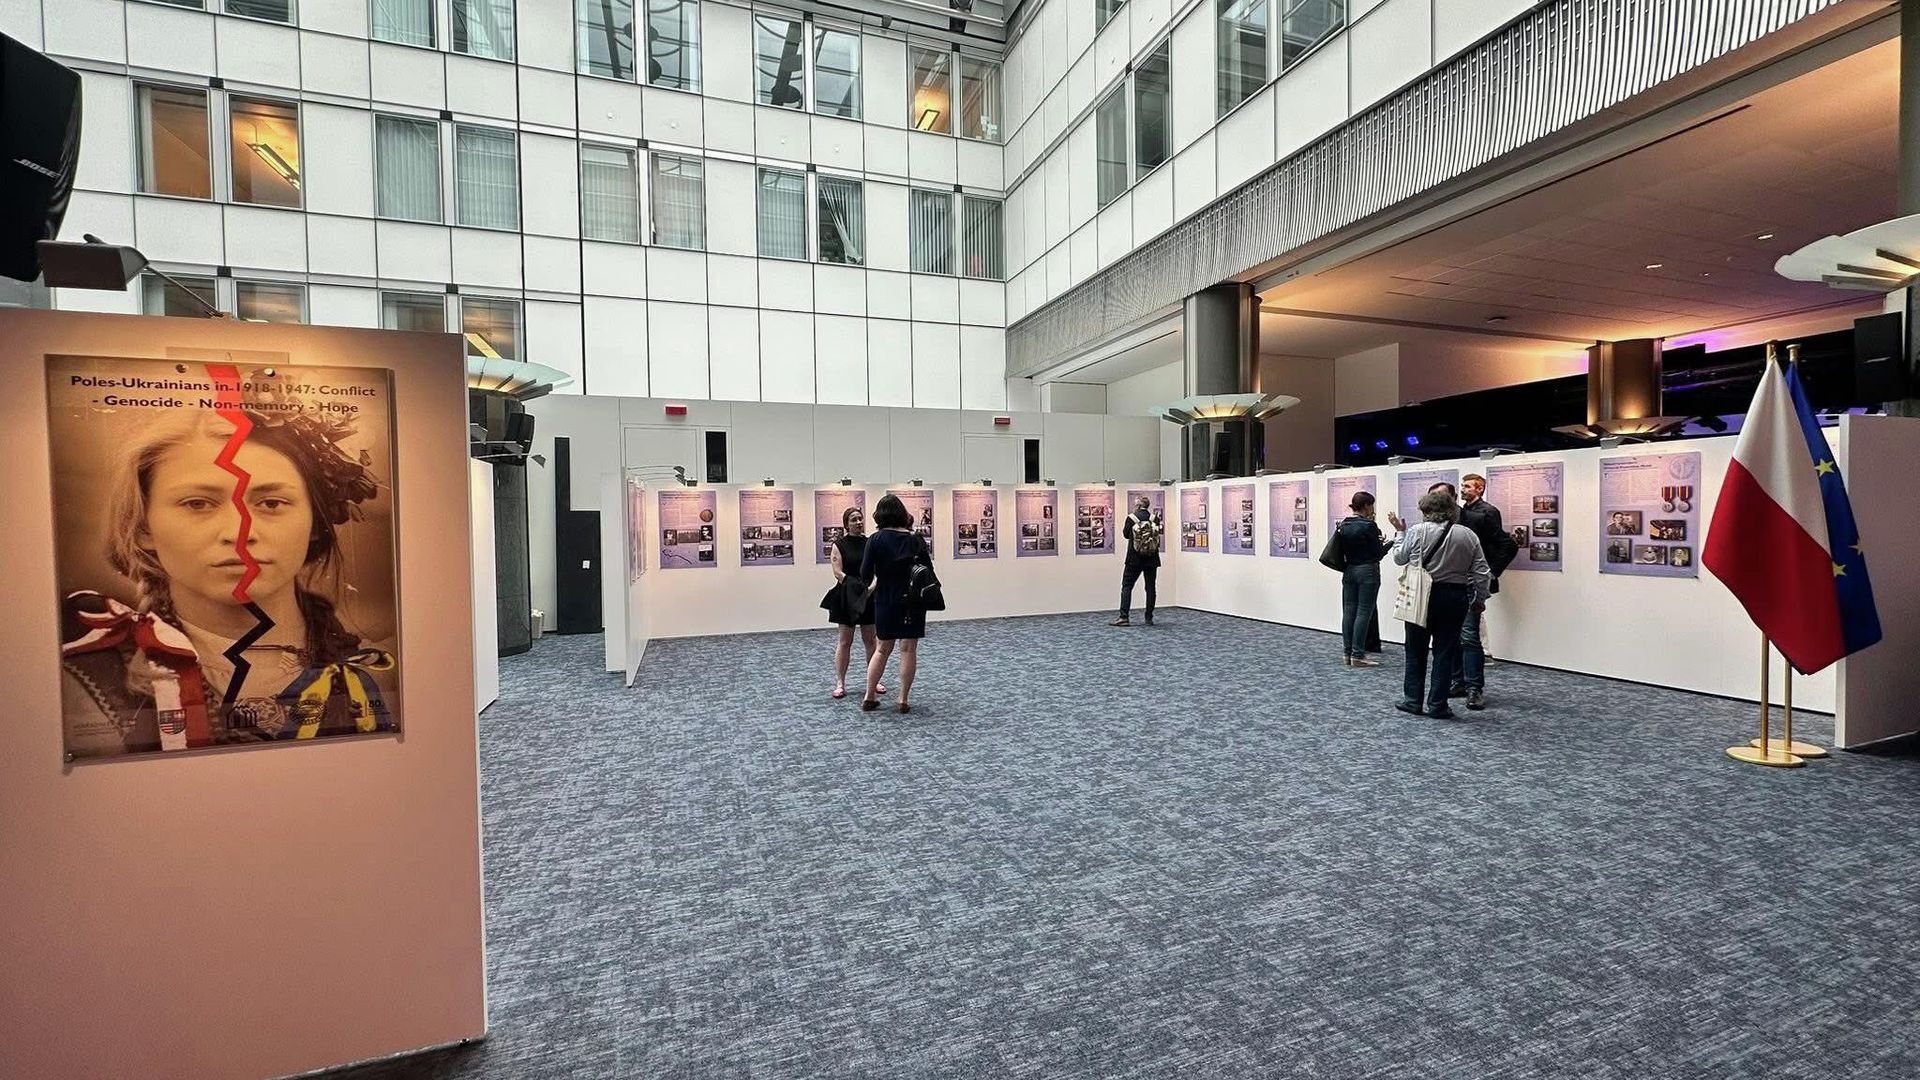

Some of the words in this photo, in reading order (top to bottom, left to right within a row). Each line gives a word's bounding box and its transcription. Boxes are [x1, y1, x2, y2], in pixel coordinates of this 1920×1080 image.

[13, 158, 61, 178] BOSE
[71, 375, 210, 391] Poles-Ukrainians
[236, 382, 316, 395] 1918-1947:
[319, 385, 376, 396] Conflict
[104, 395, 183, 408] Genocide
[199, 398, 305, 414] Non-memory
[319, 402, 359, 414] Hope
